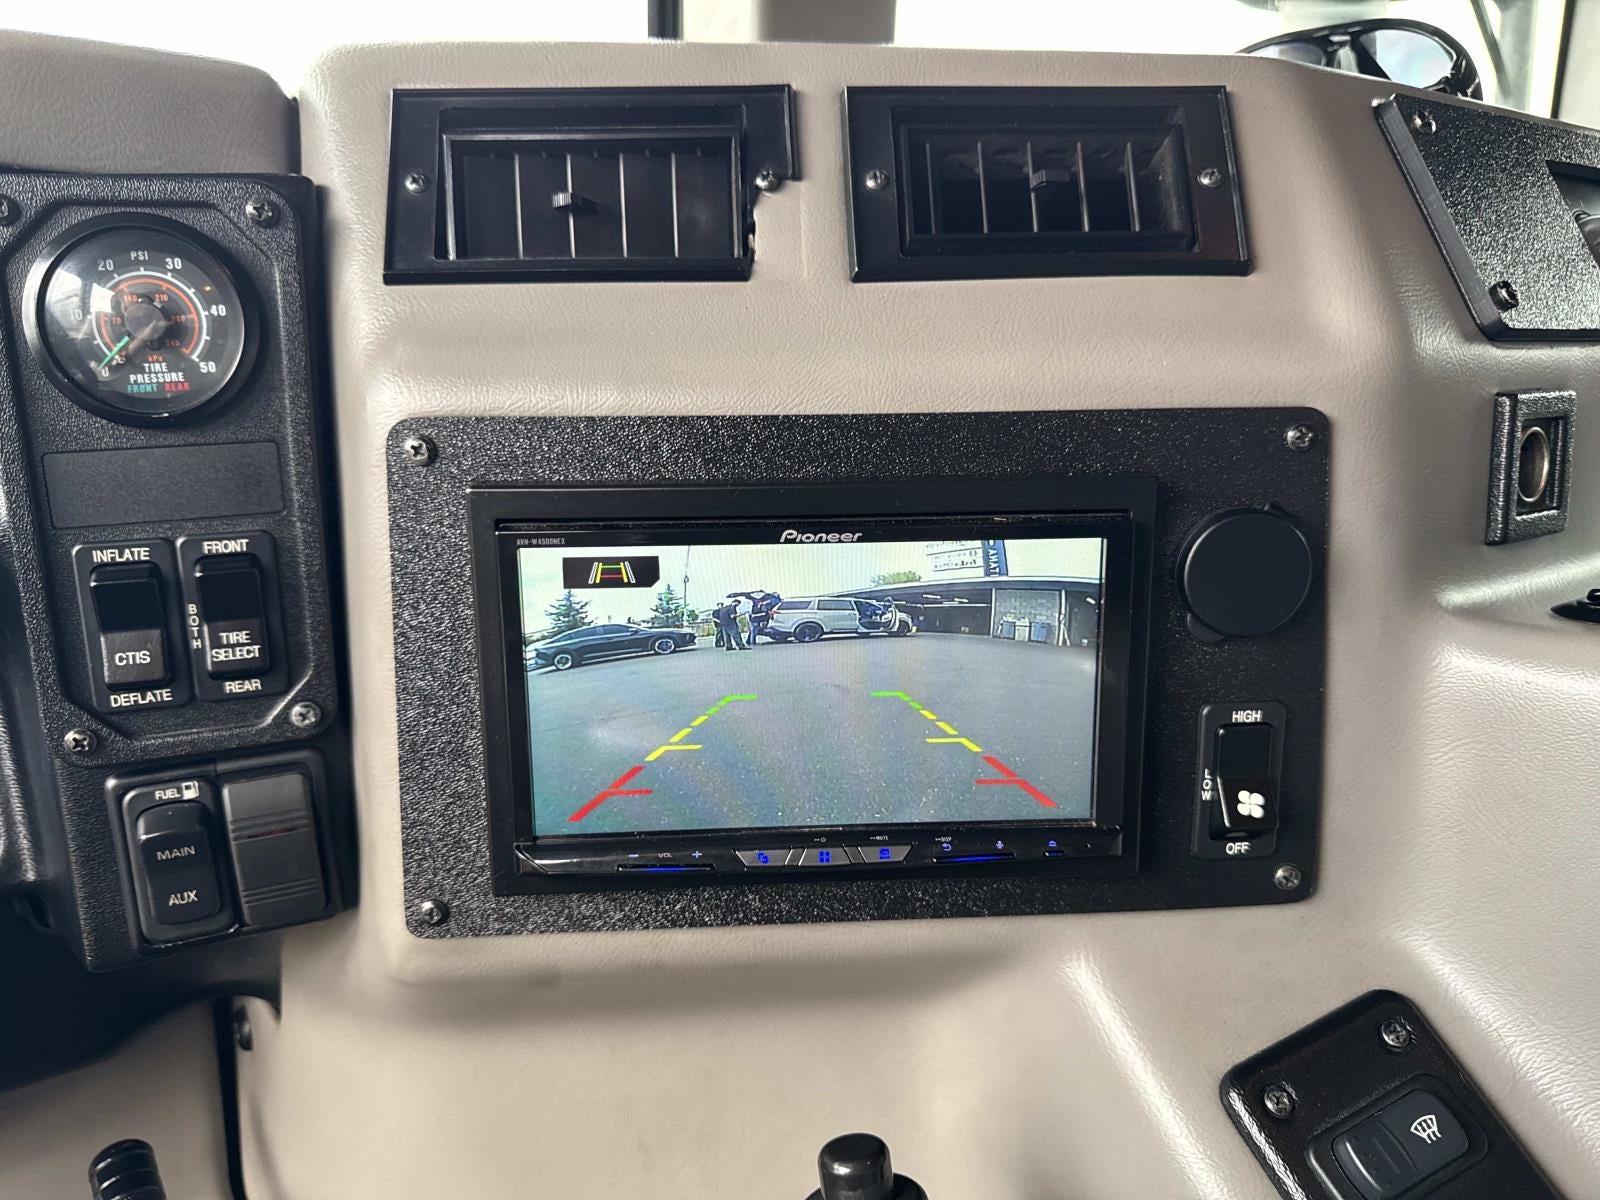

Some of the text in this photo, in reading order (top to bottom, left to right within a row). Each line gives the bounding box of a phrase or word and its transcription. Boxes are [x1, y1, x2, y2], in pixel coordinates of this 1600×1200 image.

[130, 251, 149, 261] PSI
[97, 259, 114, 271] 20
[165, 257, 182, 270] 30
[210, 304, 226, 317] 40
[143, 362, 168, 373] TIRE
[199, 361, 216, 373] 50
[129, 372, 185, 383] PRESSURE
[127, 382, 190, 393] FRONT REAR
[779, 529, 863, 543] Pioneer
[202, 539, 249, 555] FRONT
[92, 547, 151, 563] INFLATE
[188, 604, 202, 649] BOTH
[218, 631, 251, 644] TIRE
[114, 651, 151, 666] CTIS
[212, 645, 261, 662] SELECT
[223, 679, 262, 694] REAR
[110, 688, 173, 708] DEFLATE
[1232, 710, 1262, 723] HIGH
[1201, 768, 1213, 801] LOW
[155, 787, 181, 801] FUEL
[156, 845, 196, 861] MAIN
[1225, 842, 1250, 855] OFF
[168, 889, 198, 906] AUX
